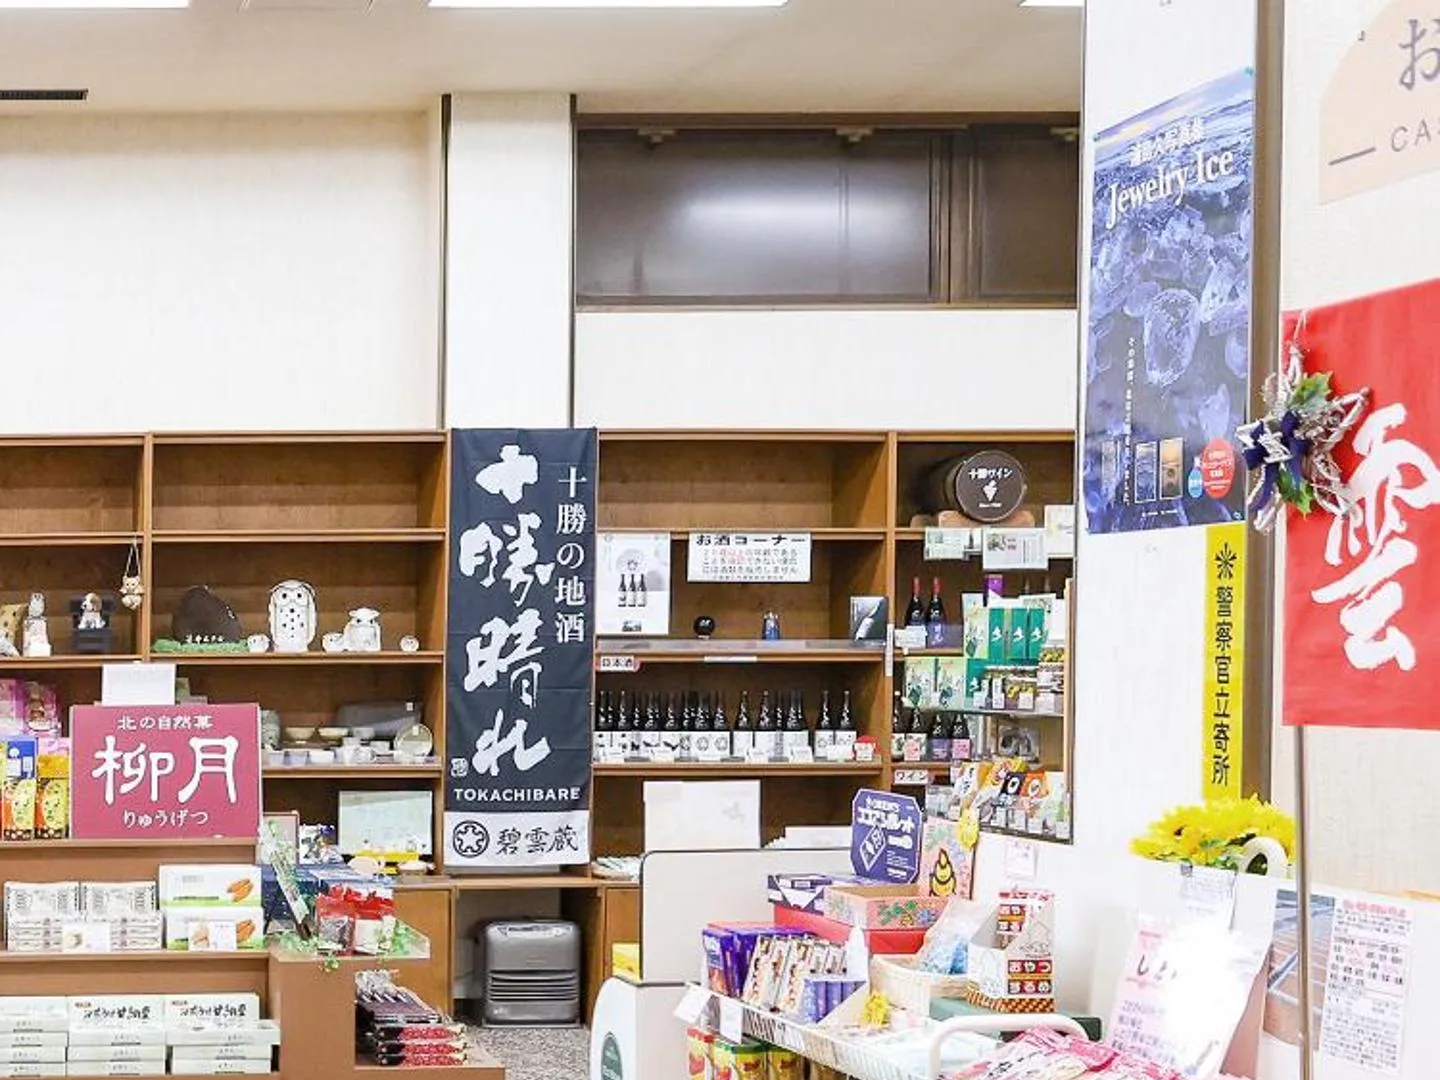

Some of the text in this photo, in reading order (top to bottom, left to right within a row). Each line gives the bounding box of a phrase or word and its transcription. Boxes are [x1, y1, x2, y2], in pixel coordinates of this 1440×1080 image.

[1390, 117, 1440, 153] CA
[1106, 149, 1234, 229] Jewelry Ice
[554, 466, 588, 644] 十勝の地酒
[696, 534, 805, 546] お酒コーナー
[460, 444, 555, 777] 十勝晴れ
[1211, 585, 1235, 787] 警察官立寄所
[91, 735, 239, 805] 柳月
[896, 771, 928, 781] ワイン
[454, 786, 581, 802] TOKACHIBARE
[123, 809, 208, 828] りゅうげつ
[495, 825, 579, 857] 碧雲蔵
